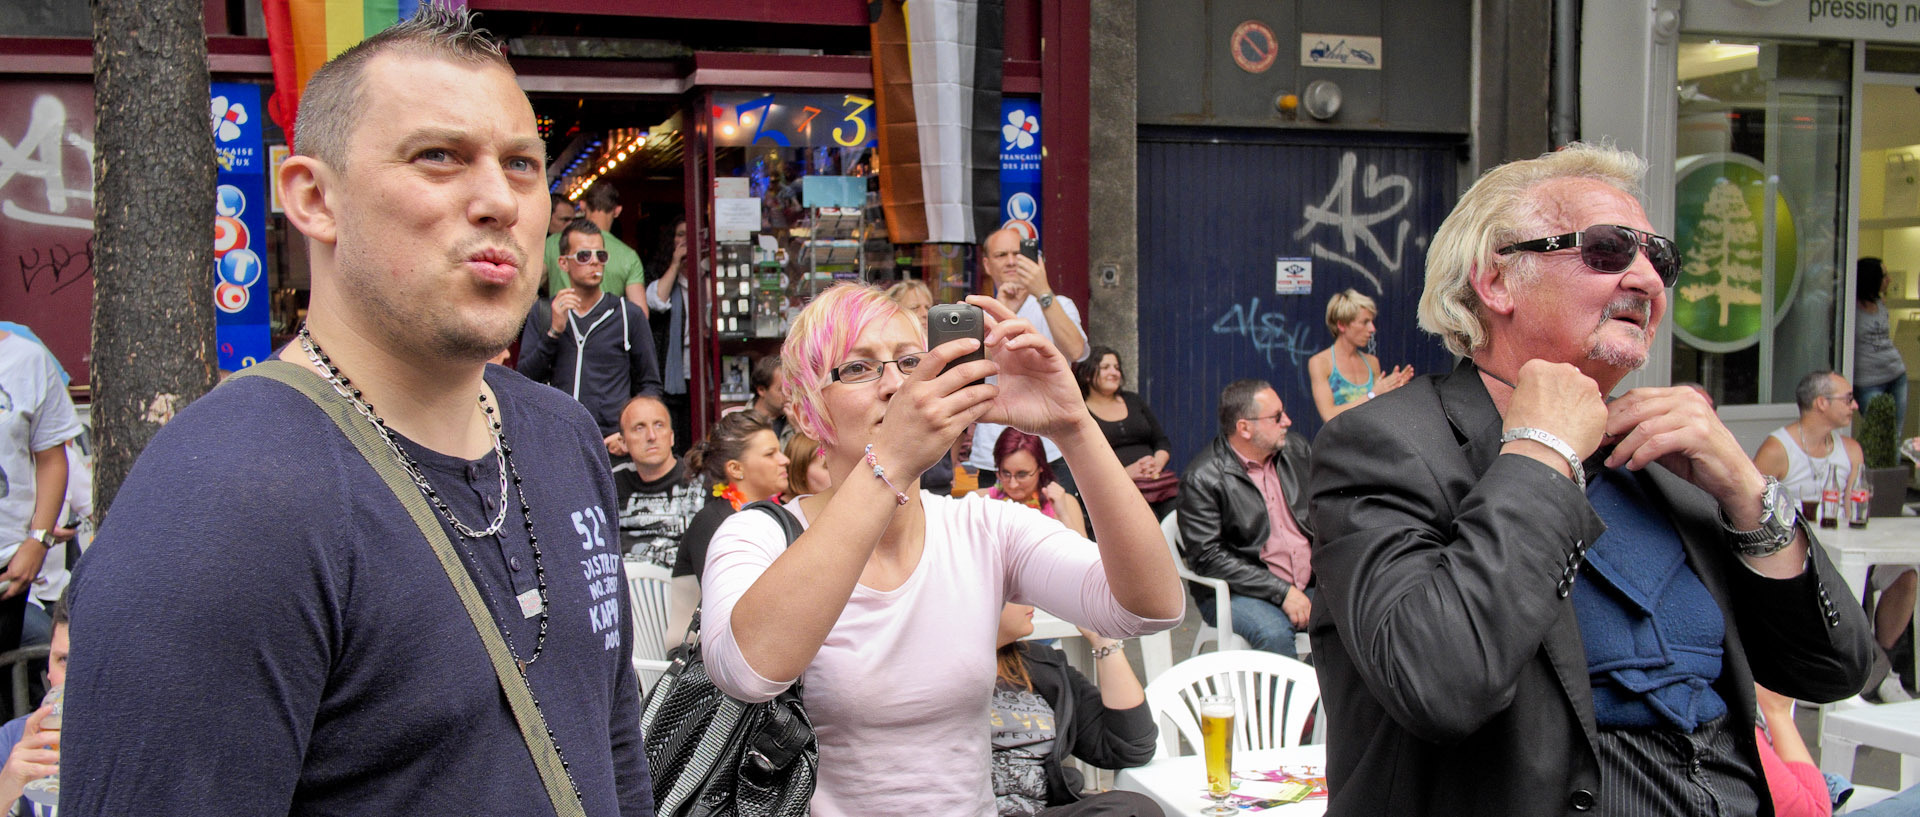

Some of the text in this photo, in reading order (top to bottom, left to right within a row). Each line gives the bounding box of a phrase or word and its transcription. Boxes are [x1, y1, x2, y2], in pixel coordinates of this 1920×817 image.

[1809, 0, 1920, 28] pressing n
[797, 105, 821, 132] 7
[832, 95, 874, 146] 3
[229, 157, 250, 166] EUX
